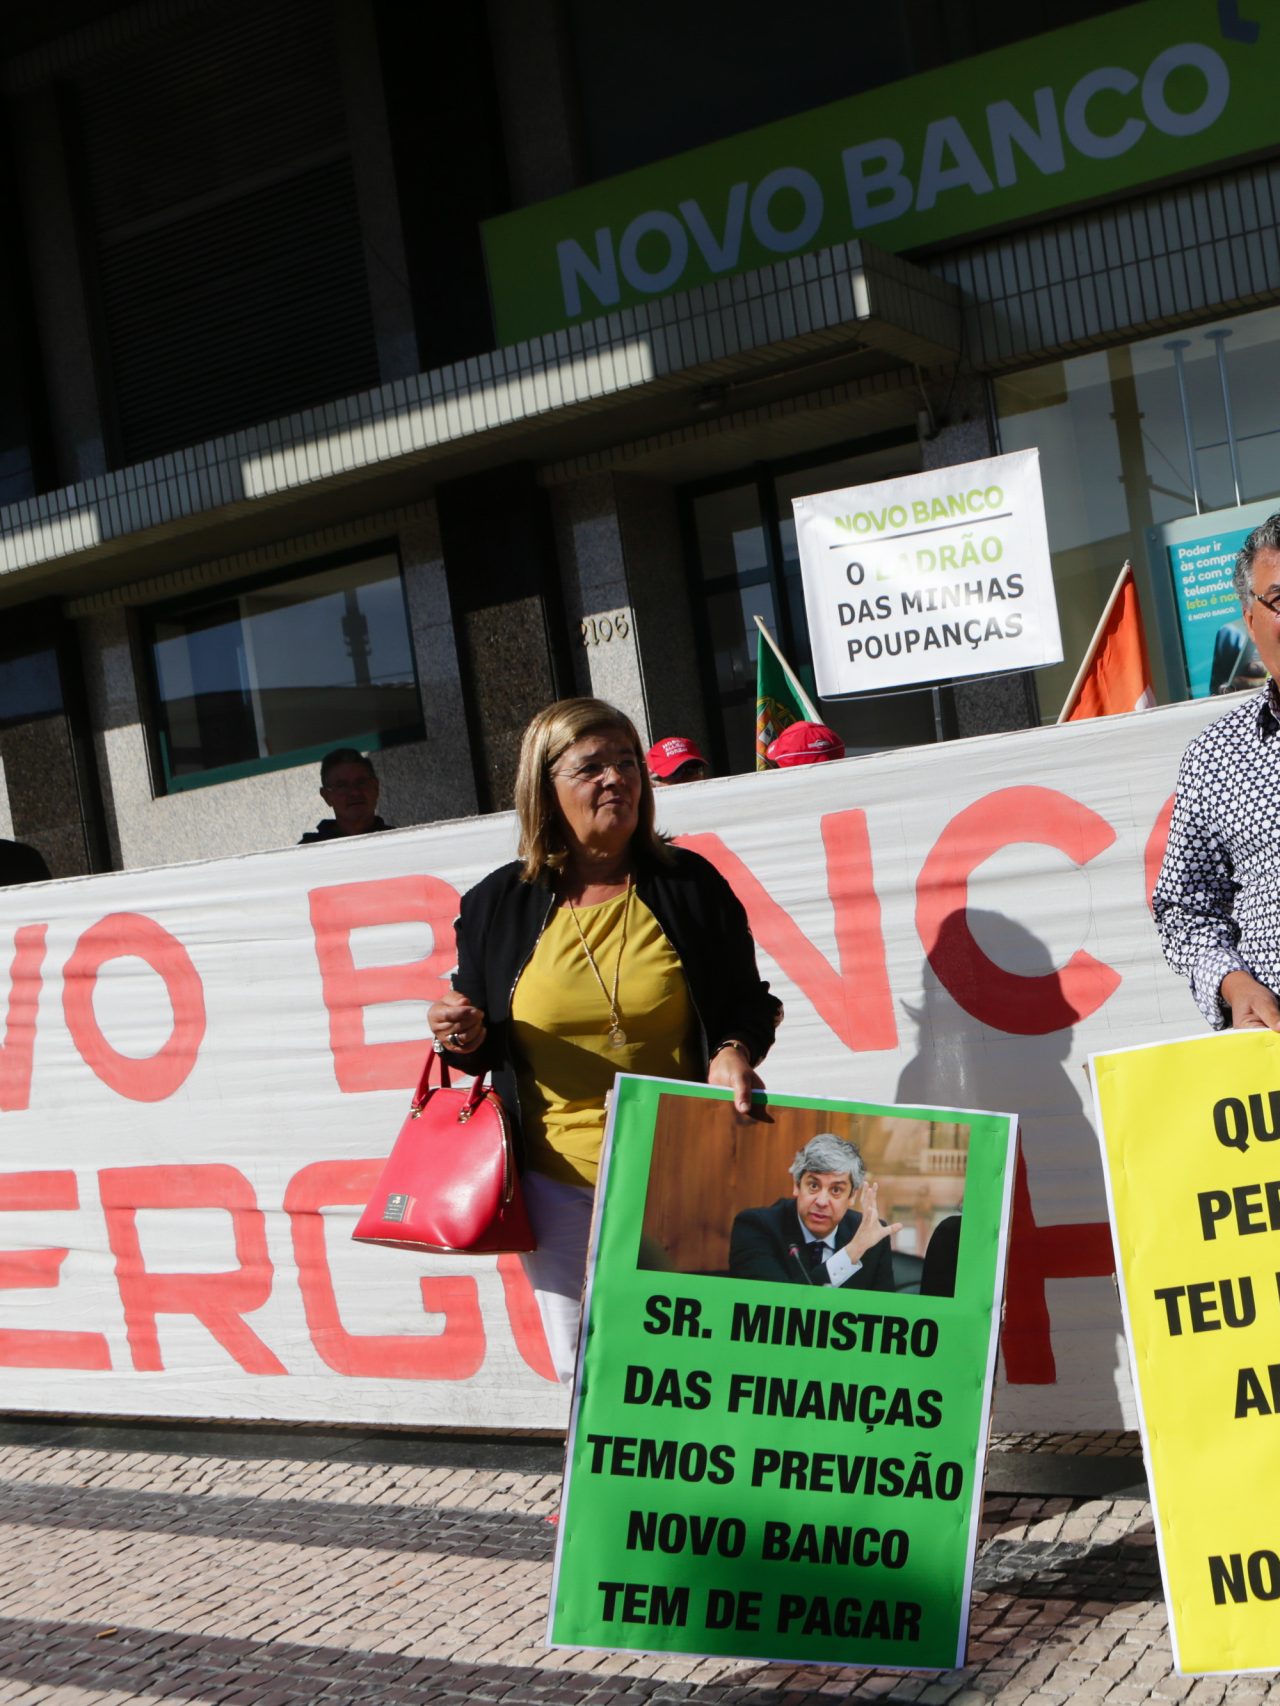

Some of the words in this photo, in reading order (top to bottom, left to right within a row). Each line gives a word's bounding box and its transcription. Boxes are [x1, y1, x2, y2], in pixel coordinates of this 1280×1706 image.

[556, 167, 824, 317] NOVO
[841, 43, 1230, 230] BANCO
[834, 504, 908, 534] NOVO
[911, 485, 1004, 525] BANCO
[846, 561, 865, 585] O
[1178, 544, 1211, 559] Poder
[1213, 541, 1222, 552] ir
[1180, 561, 1194, 571] às
[1196, 552, 1240, 568] compra
[1182, 573, 1196, 584] só
[1198, 570, 1222, 581] com
[1224, 567, 1232, 575] o
[837, 595, 892, 626] DAS
[900, 573, 1025, 616] MINHAS
[1192, 612, 1211, 620] NOVO
[1210, 595, 1217, 604] é
[847, 612, 1024, 662] POUPANÇAS
[643, 1294, 713, 1339] SR.
[730, 1302, 940, 1358] MINISTRO
[1153, 1275, 1257, 1337] TEU
[623, 1364, 713, 1411] DAS
[727, 1373, 944, 1434] FINANÇAS
[586, 1433, 736, 1486] TEMOS
[750, 1448, 964, 1502] PREVISÃO
[625, 1510, 747, 1560] NOVO
[760, 1520, 911, 1570] BANCO
[597, 1581, 691, 1628] TEM
[704, 1588, 763, 1633] DE
[775, 1595, 923, 1643] PAGAR
